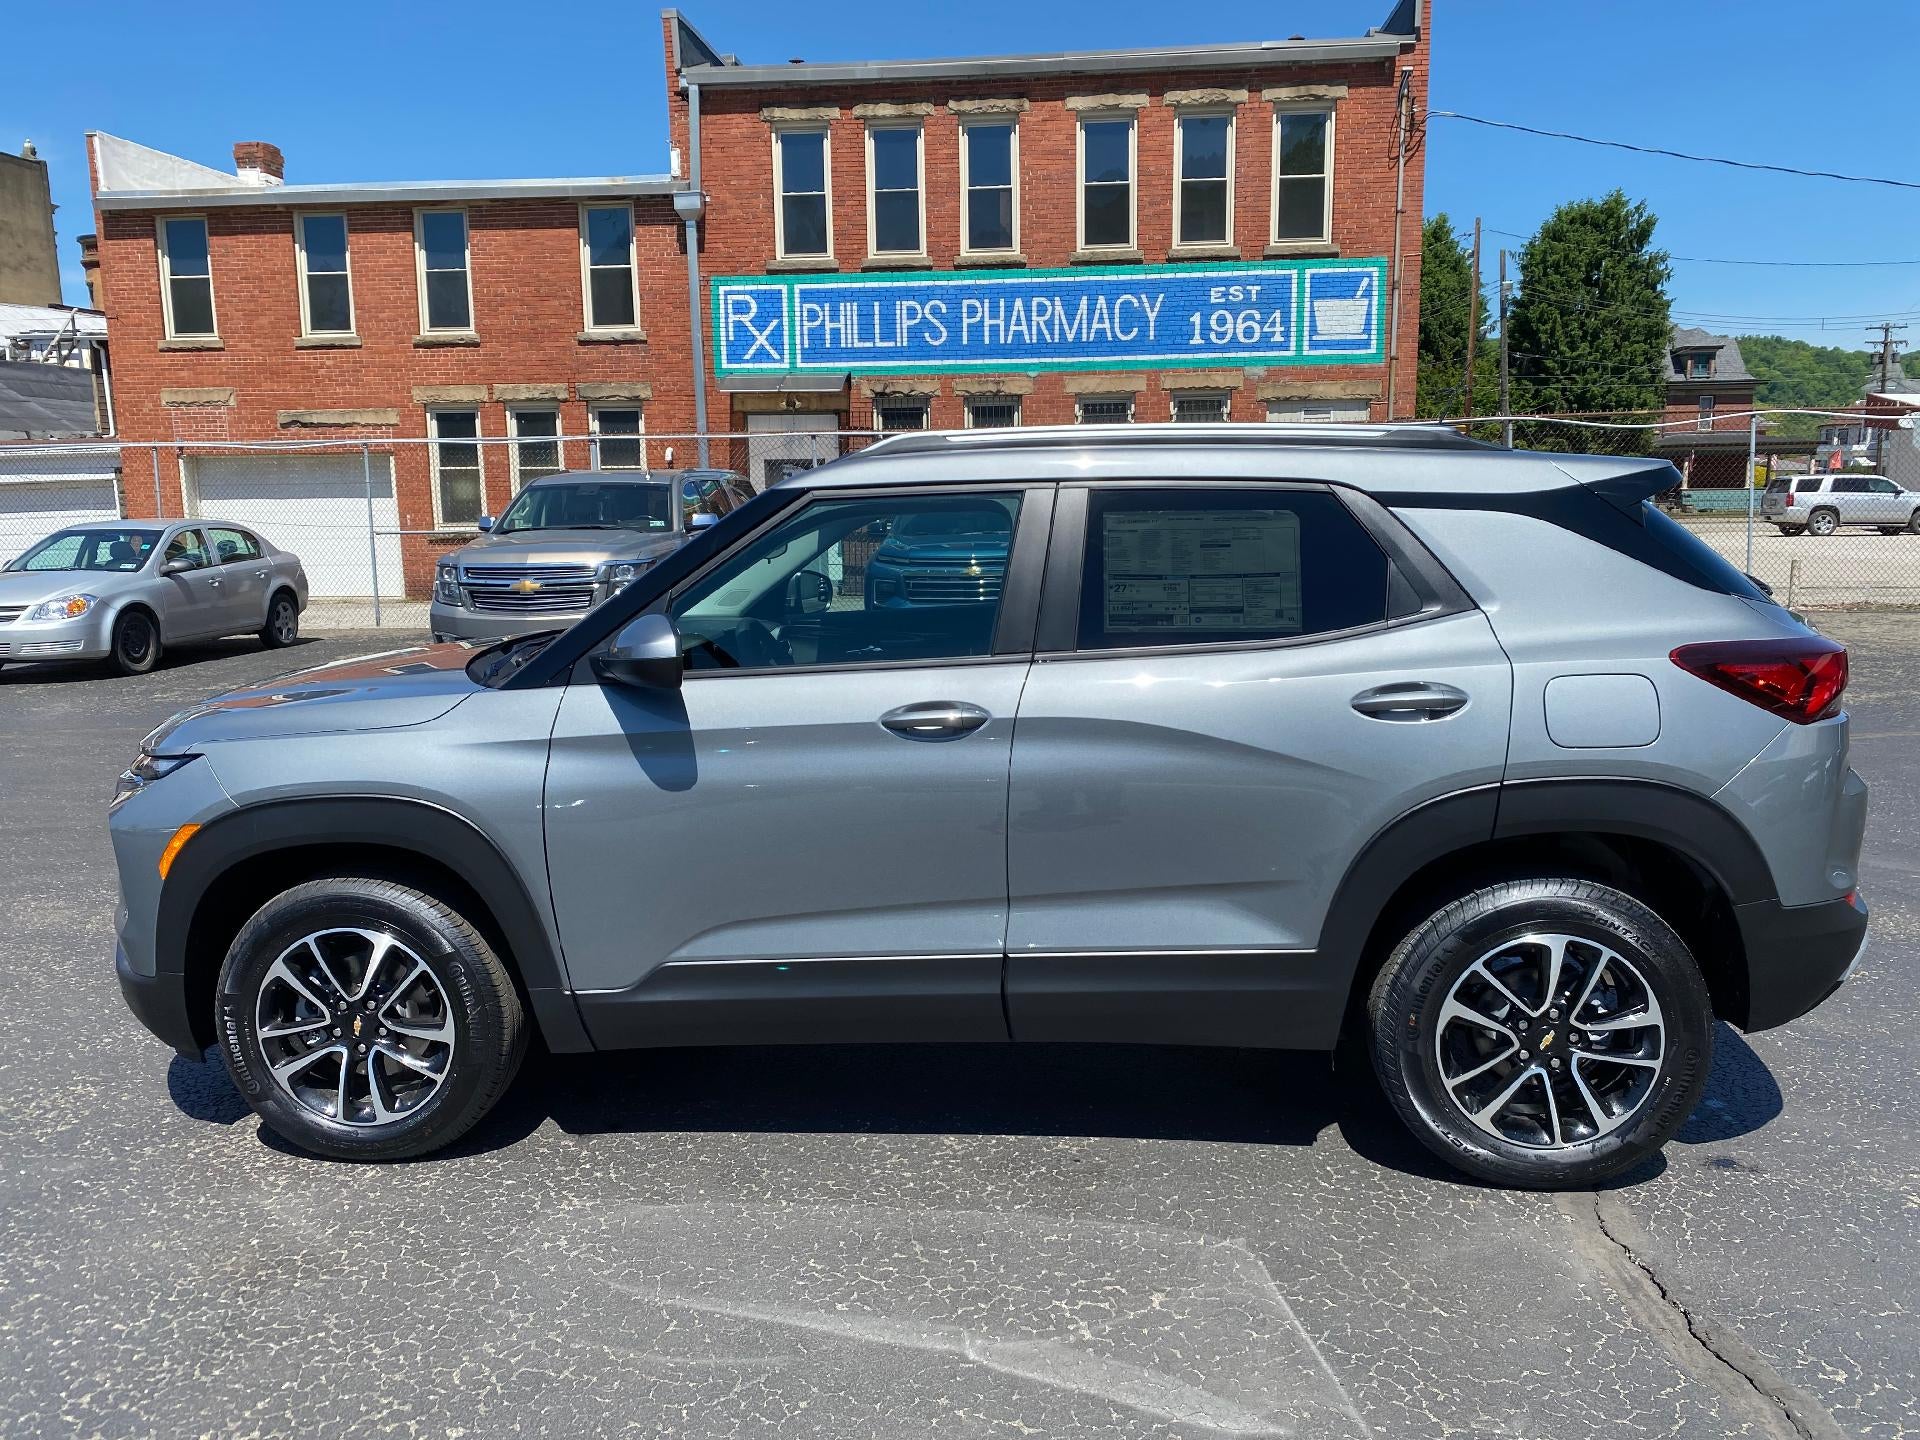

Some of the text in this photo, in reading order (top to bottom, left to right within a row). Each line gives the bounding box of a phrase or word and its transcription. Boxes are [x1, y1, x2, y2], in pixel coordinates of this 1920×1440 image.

[1210, 285, 1262, 304] EST
[802, 293, 1165, 348] PHILLIPS PHARMACY
[1189, 309, 1285, 345] 1964
[223, 1014, 261, 1095] Continental
